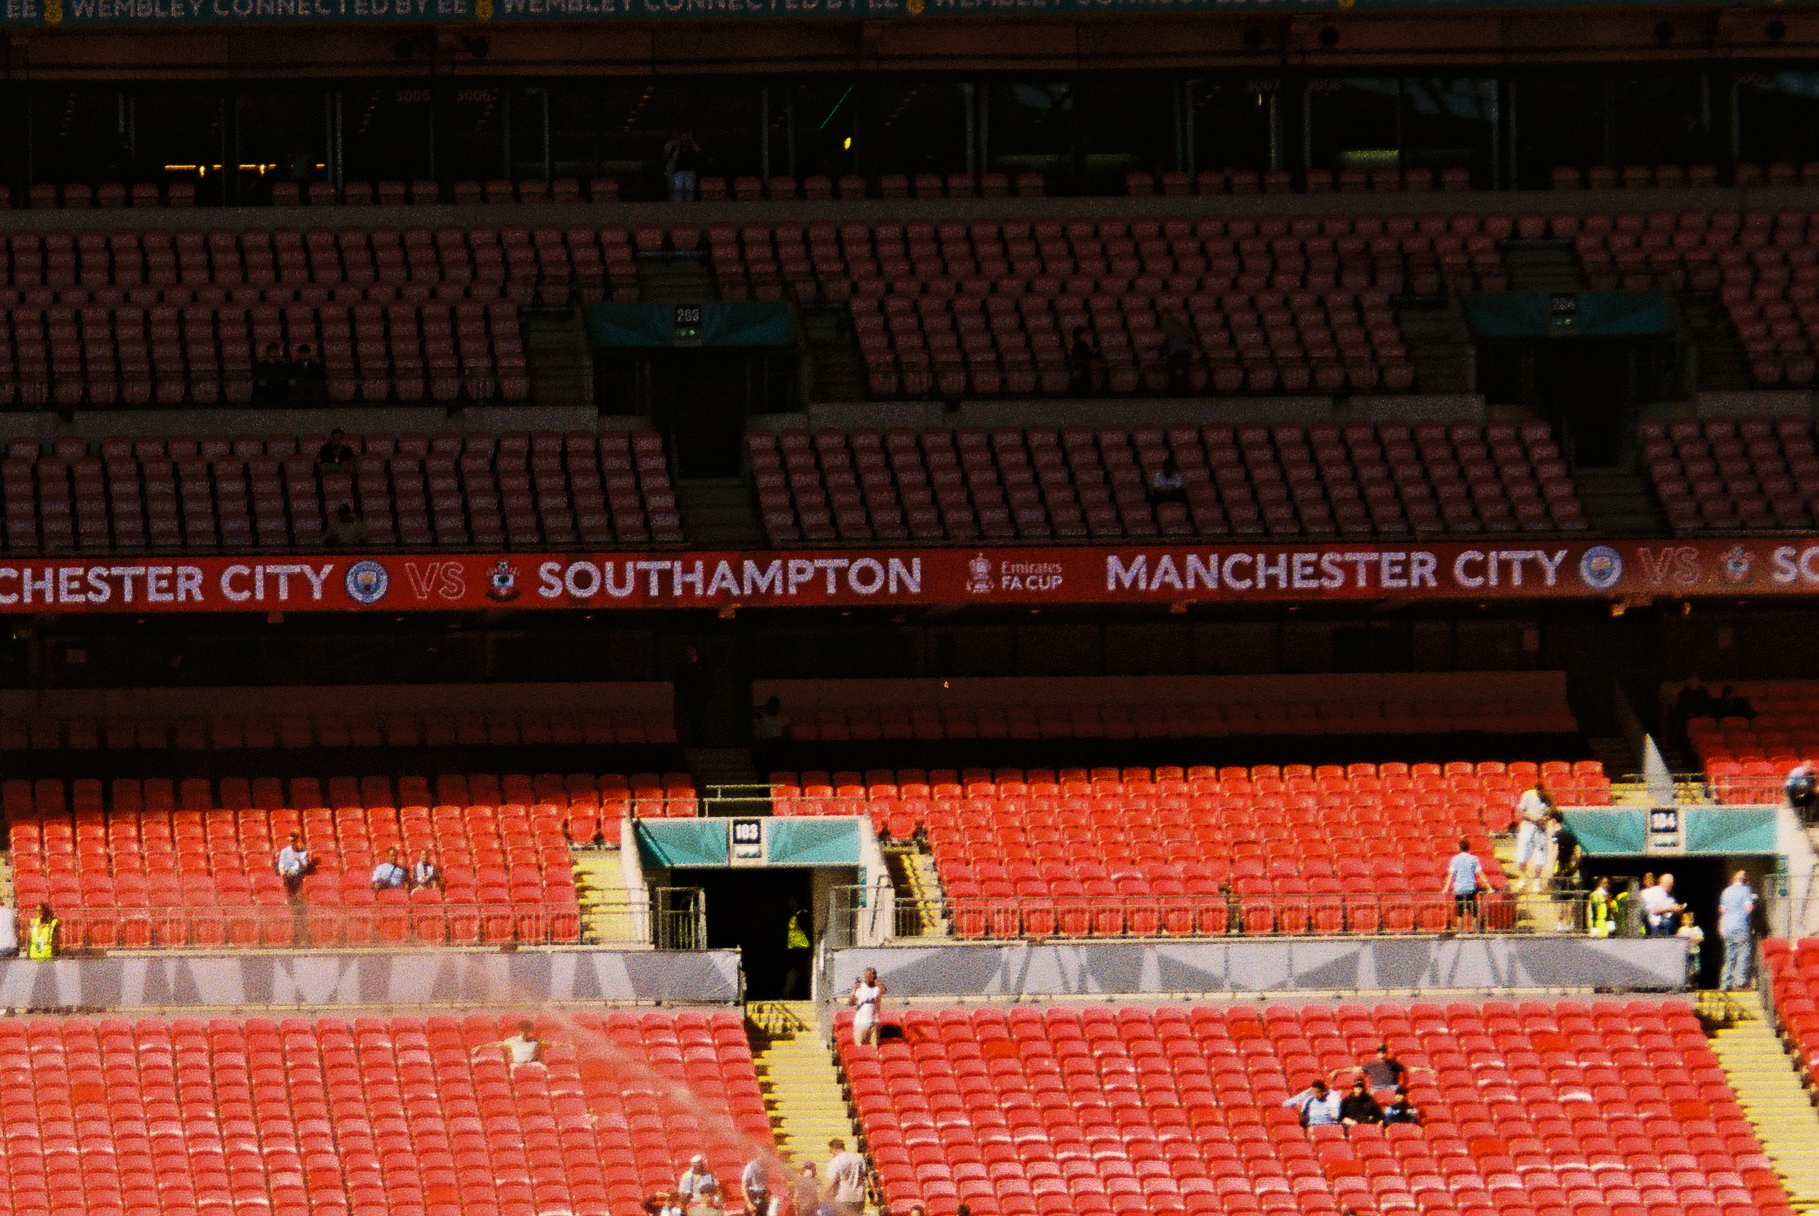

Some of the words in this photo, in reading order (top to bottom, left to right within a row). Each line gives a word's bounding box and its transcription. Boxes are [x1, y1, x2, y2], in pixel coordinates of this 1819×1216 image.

[6, 0, 37, 19] EE
[72, 0, 202, 18] WEMBLEY
[213, 0, 390, 17] CONNECTED
[1001, 561, 1062, 574] Emirates
[1106, 552, 1438, 591] MANCHESTER
[1452, 549, 1568, 588] CITY
[1636, 547, 1701, 585] VS
[220, 564, 334, 602] CITY
[404, 561, 466, 600] VS
[538, 558, 921, 599] SOUTHAMPTON
[1001, 575, 1023, 591] FA
[1025, 575, 1063, 590] CUP
[735, 823, 759, 840] 103
